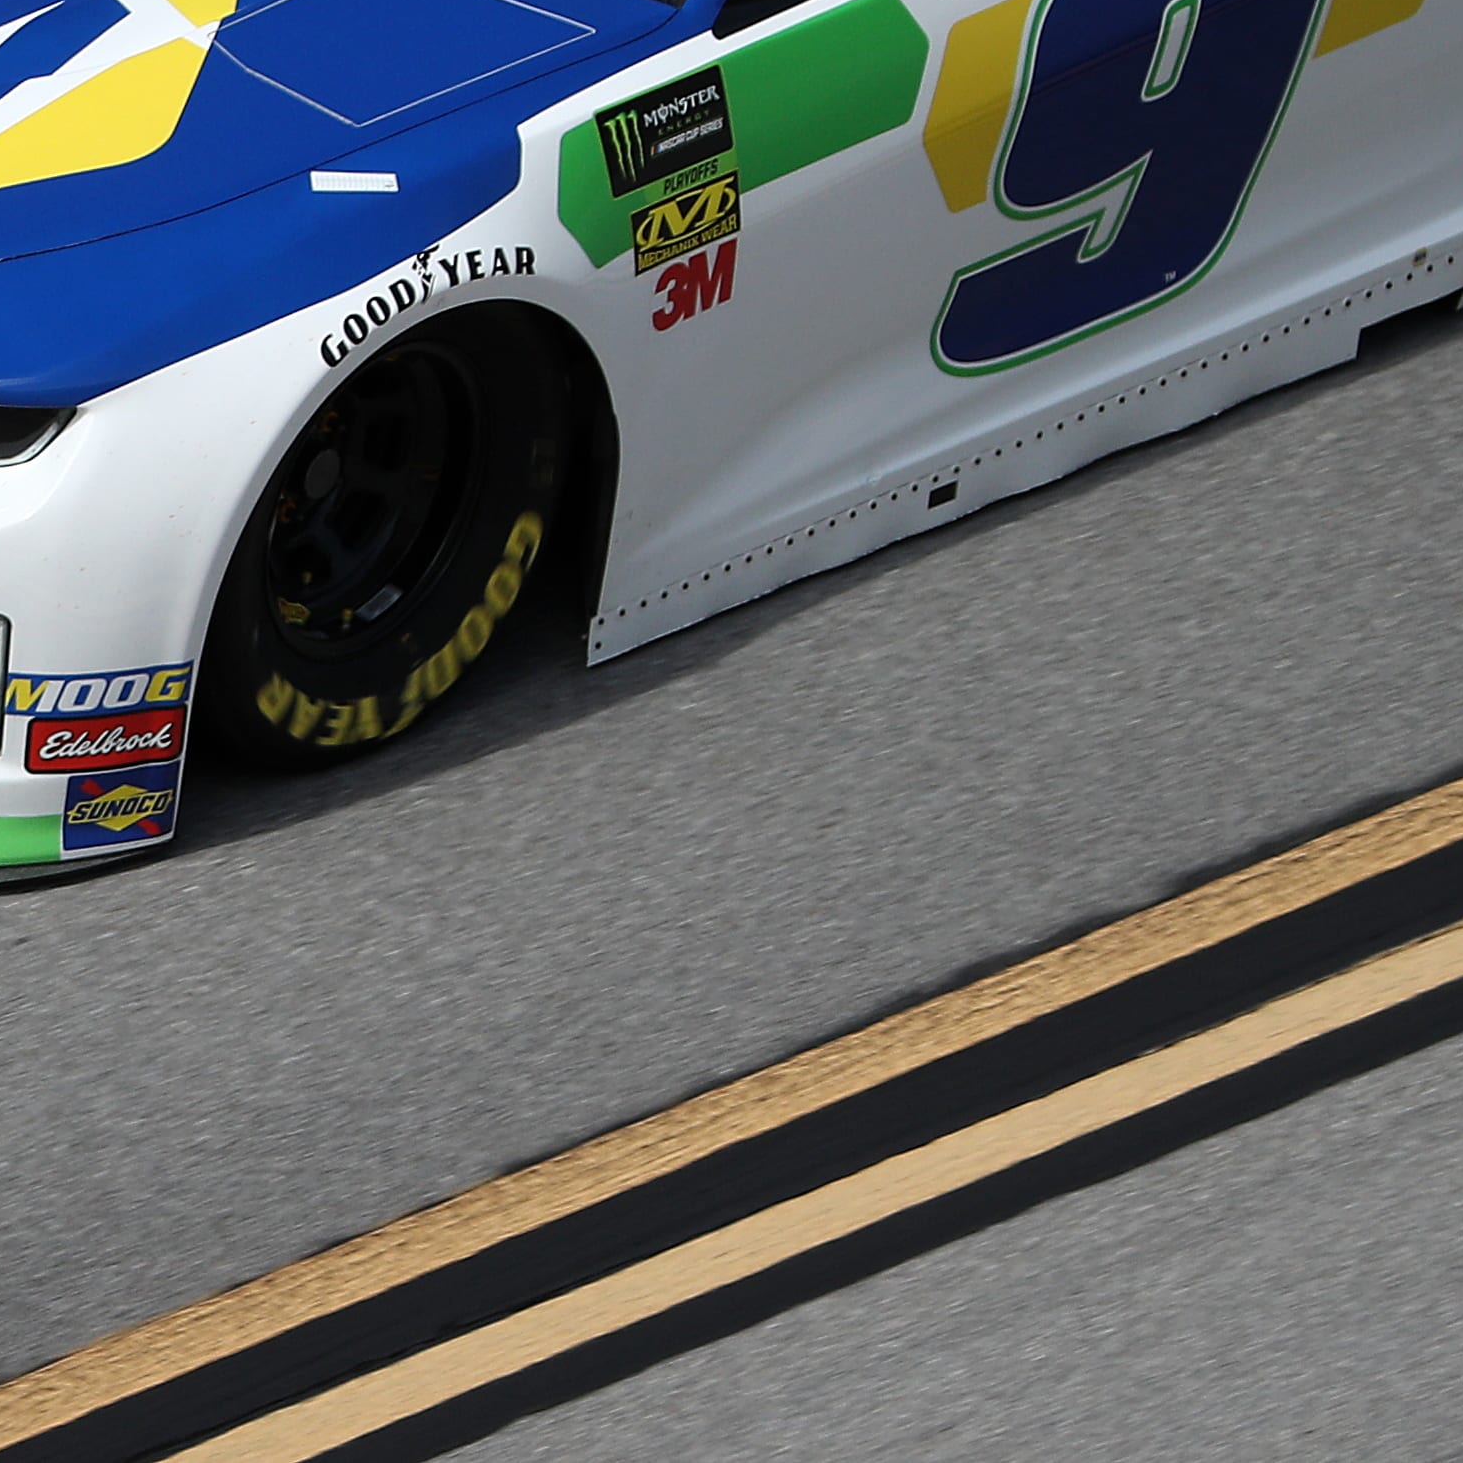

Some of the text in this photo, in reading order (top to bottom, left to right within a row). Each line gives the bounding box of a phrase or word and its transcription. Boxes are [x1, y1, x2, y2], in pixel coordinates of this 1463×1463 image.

[643, 84, 721, 128] MONSTER
[662, 157, 720, 195] PLAYOFFS
[638, 213, 738, 273] MECHANIX WEAR
[651, 237, 739, 332] 3M
[5, 662, 191, 716] MOOG
[38, 721, 175, 762] Edelbrock
[67, 786, 176, 825] SUNOCO
